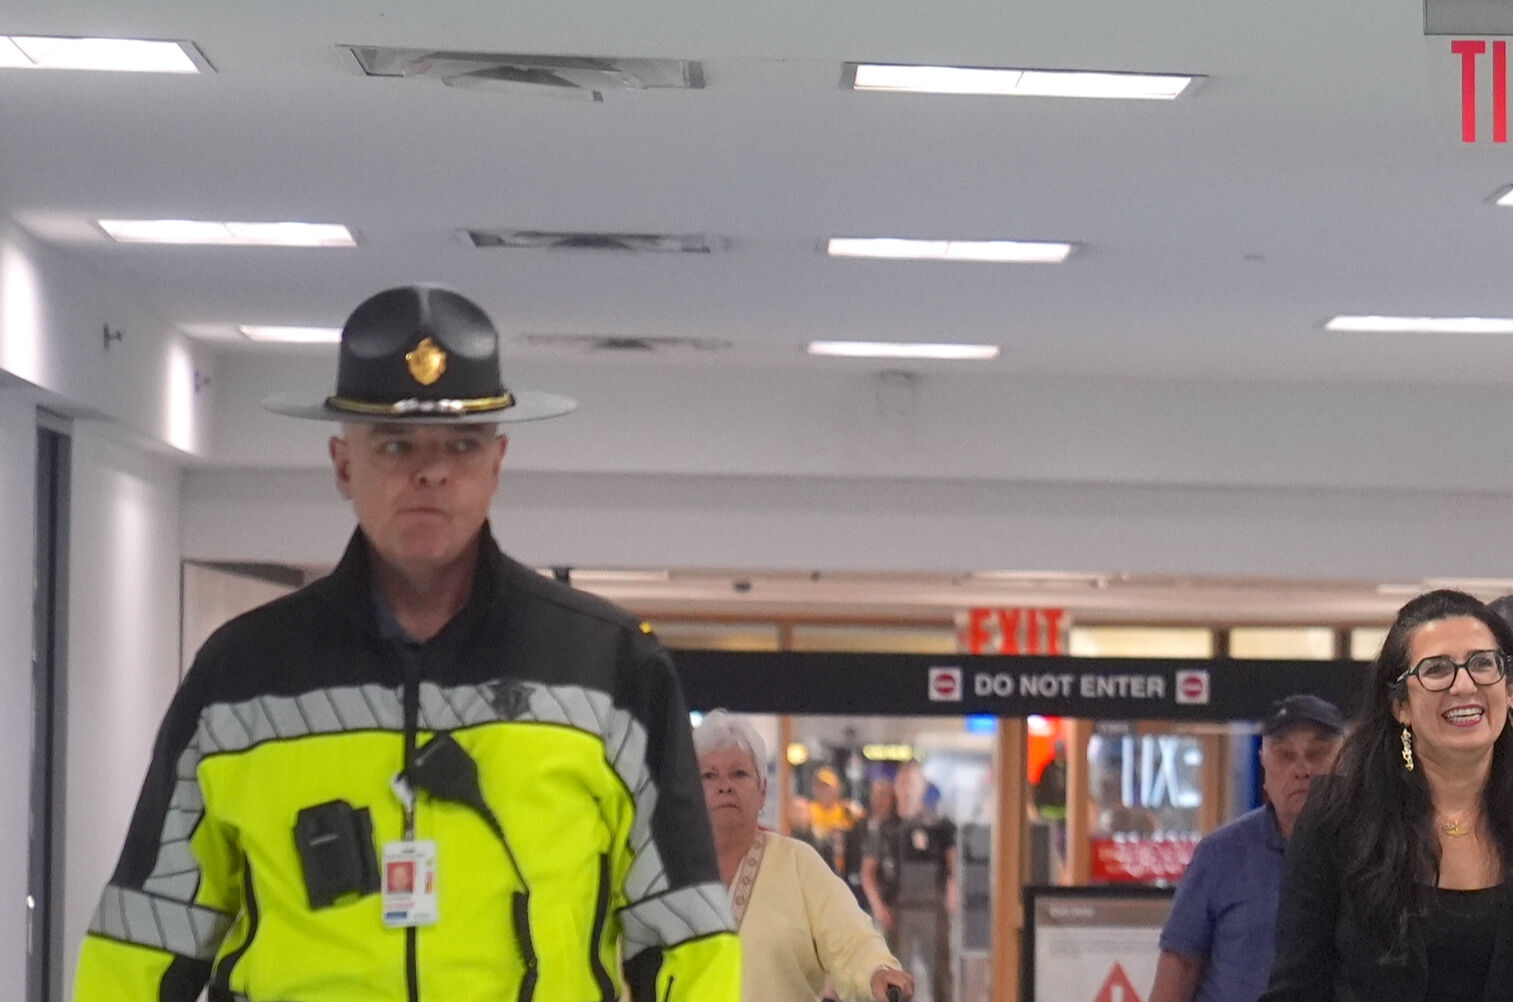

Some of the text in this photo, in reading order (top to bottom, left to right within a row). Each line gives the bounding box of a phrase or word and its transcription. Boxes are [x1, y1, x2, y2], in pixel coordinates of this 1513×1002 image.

[968, 607, 1065, 655] EXIT
[974, 673, 1166, 699] DO NOT ENTER
